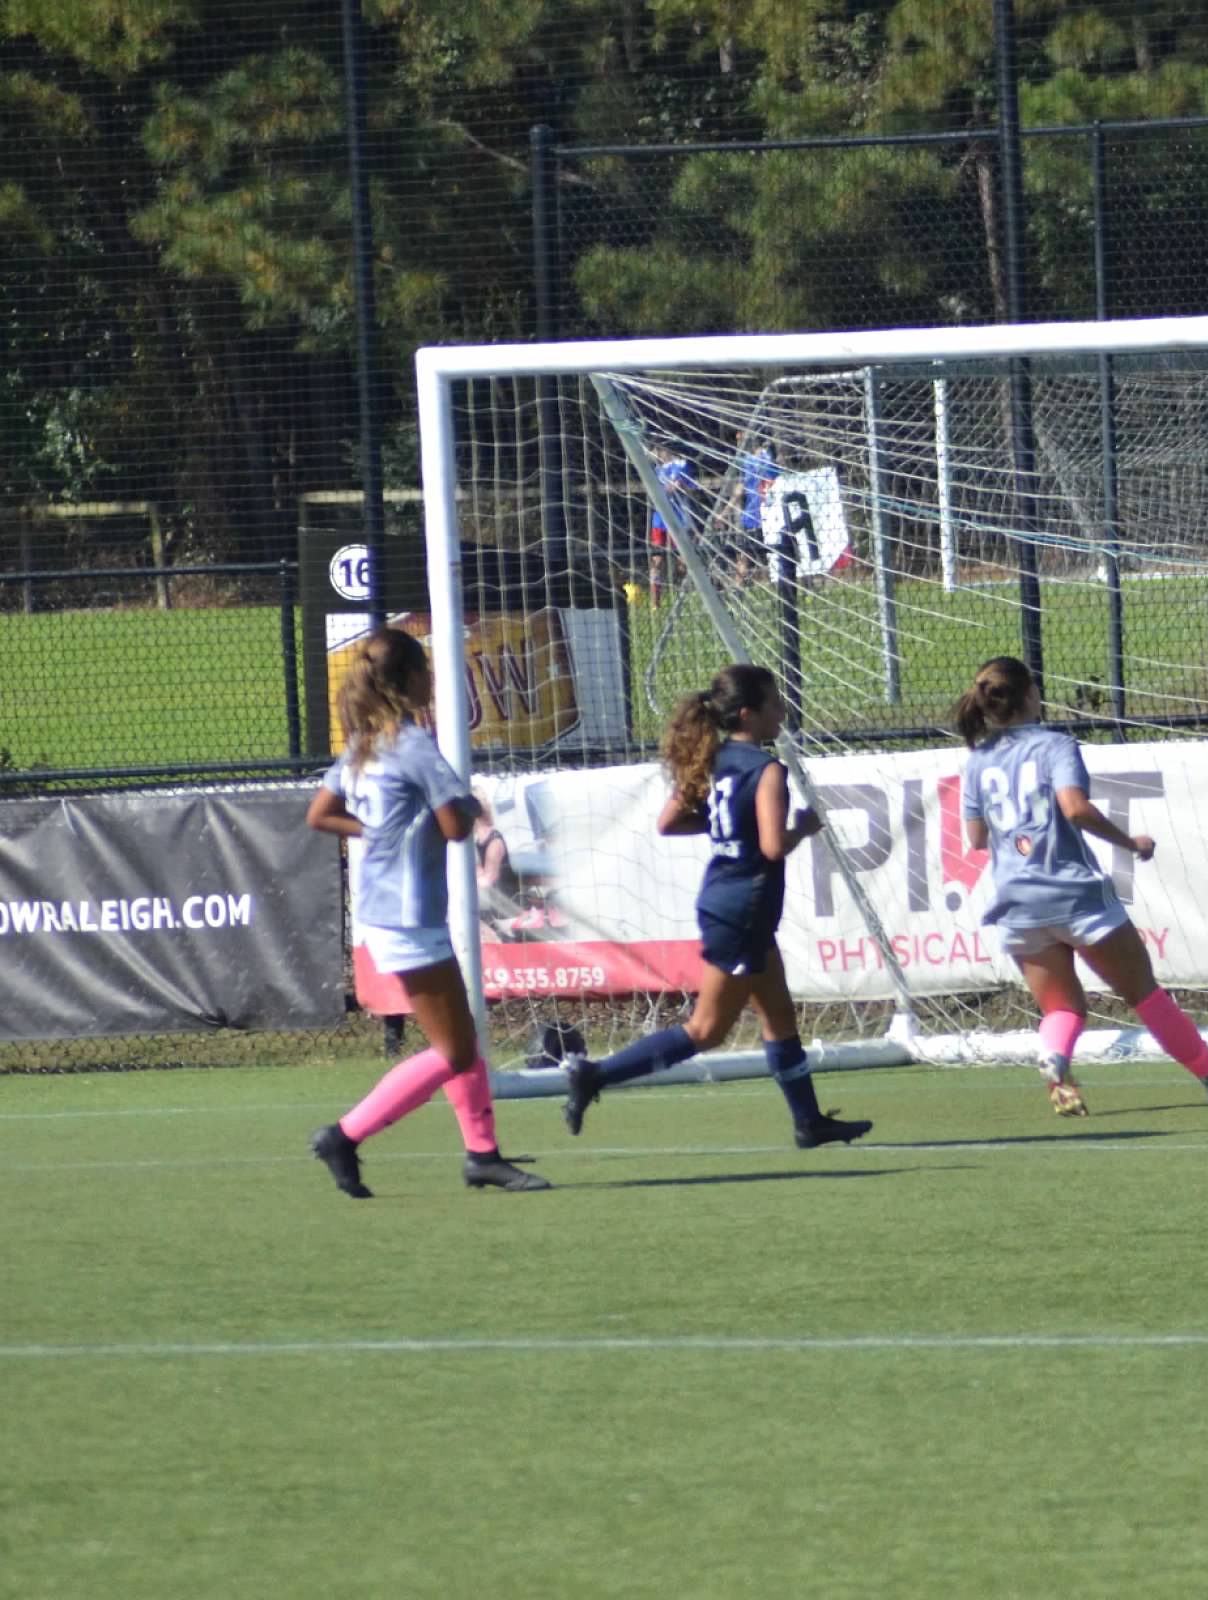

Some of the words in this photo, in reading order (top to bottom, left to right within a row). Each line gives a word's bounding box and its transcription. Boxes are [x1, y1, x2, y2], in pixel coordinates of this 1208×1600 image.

[338, 558, 371, 588] 16
[981, 760, 1051, 832] 34
[816, 930, 992, 973] PHYSICAL
[483, 966, 605, 989] 19.535.8759
